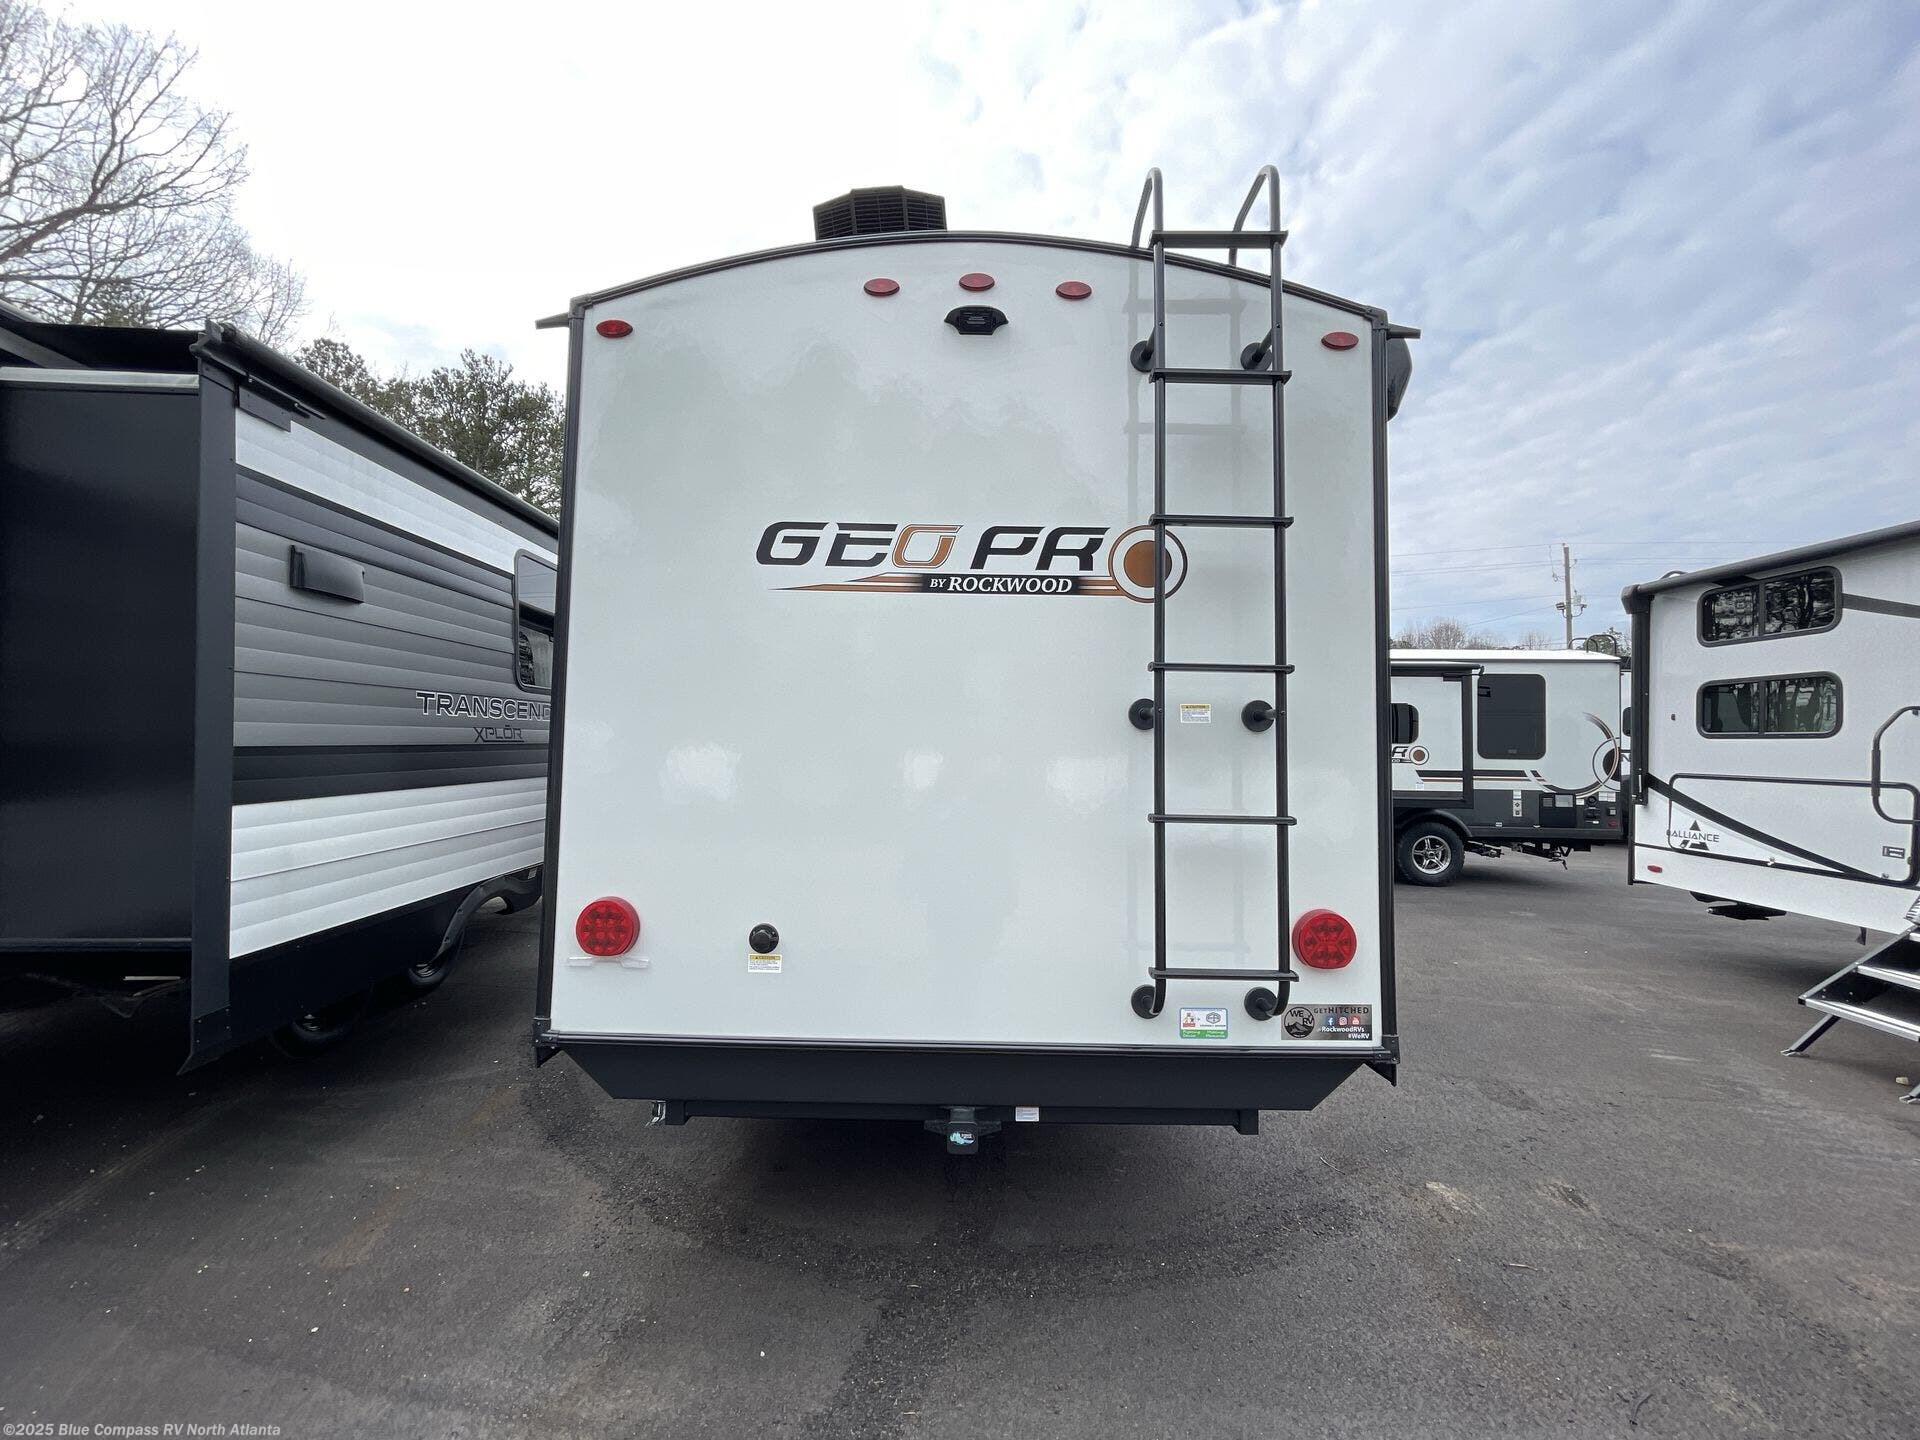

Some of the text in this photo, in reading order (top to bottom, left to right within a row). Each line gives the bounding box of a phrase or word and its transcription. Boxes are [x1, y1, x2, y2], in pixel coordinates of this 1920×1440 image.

[756, 521, 963, 568] GEO
[929, 577, 1073, 594] BY ROCKWOOD
[1671, 830, 1720, 843] ALLIANCE
[1290, 1010, 1304, 1018] WE
